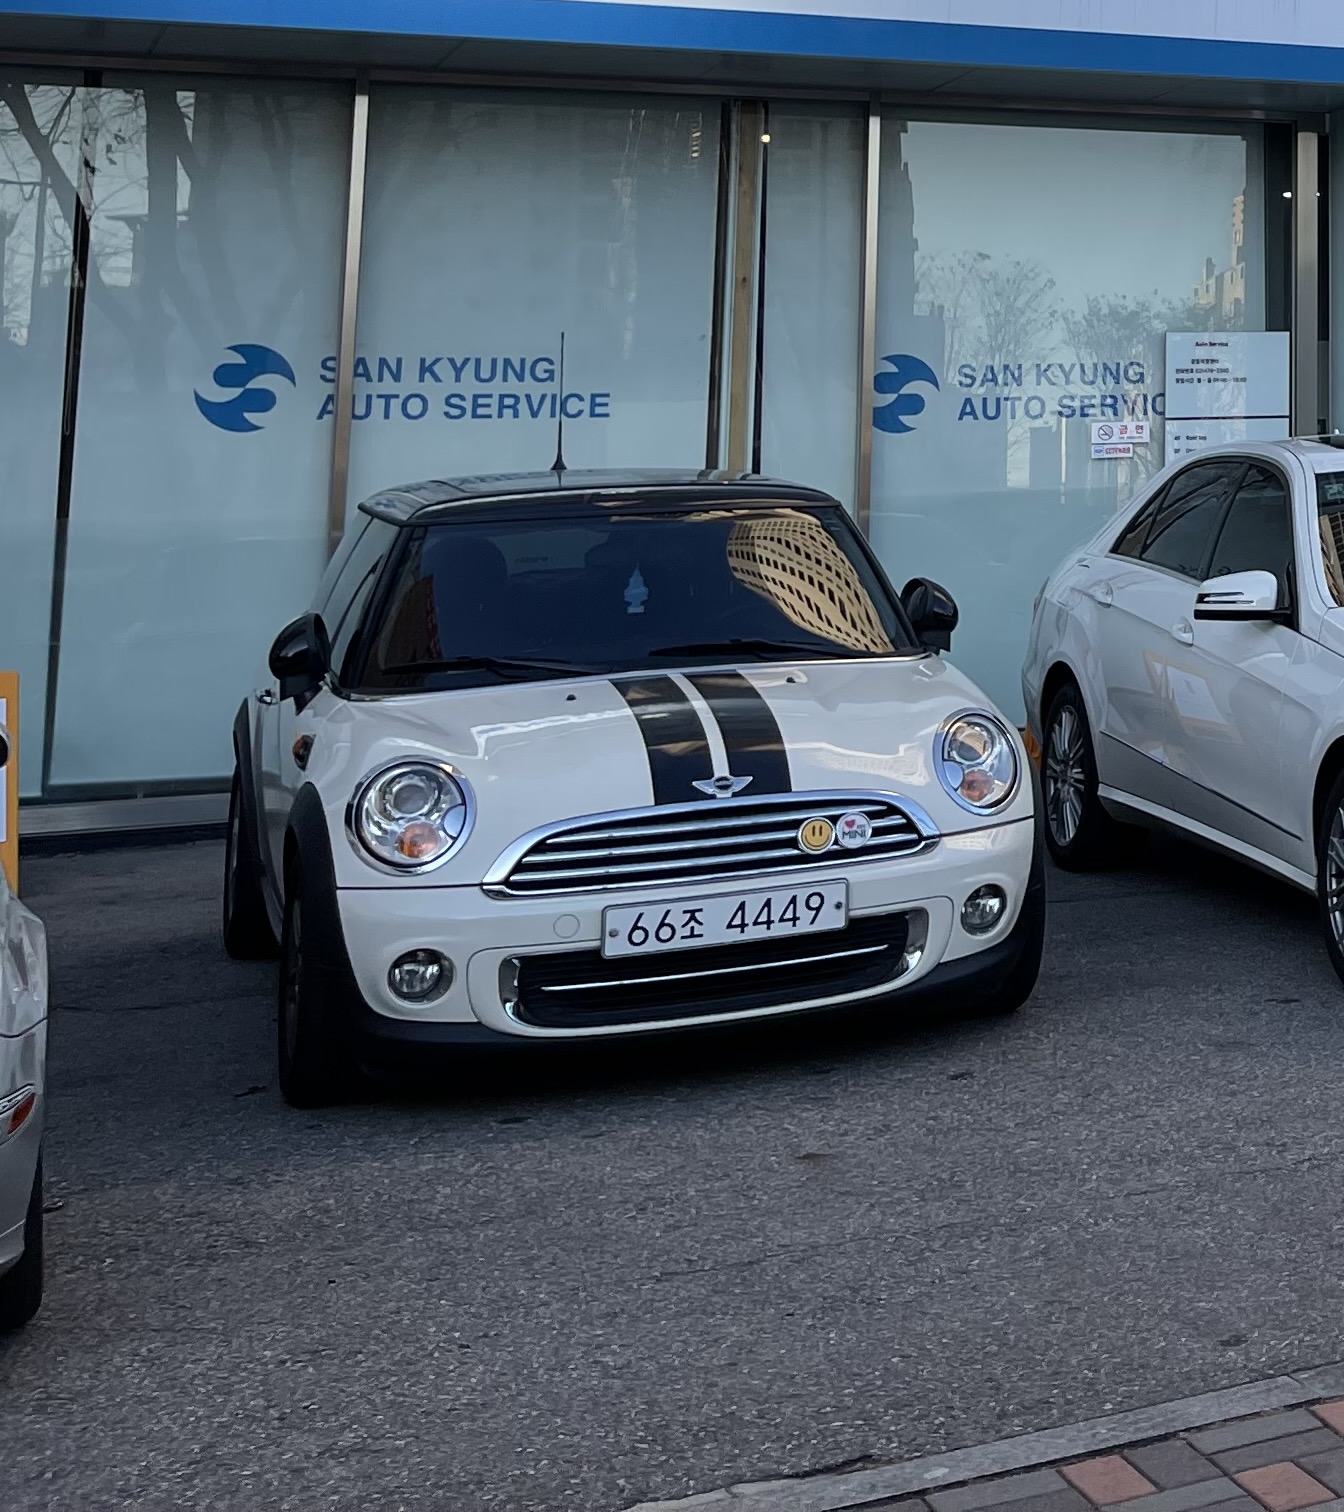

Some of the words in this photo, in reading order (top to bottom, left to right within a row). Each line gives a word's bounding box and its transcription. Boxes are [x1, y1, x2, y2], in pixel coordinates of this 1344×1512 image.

[319, 356, 404, 384] SAN
[418, 356, 556, 384] KYUNG
[957, 363, 1023, 390] SAN
[1034, 360, 1146, 387] KYUNG
[317, 392, 430, 420] AUTO
[443, 392, 611, 420] SERVICE
[957, 395, 1046, 423] AUTO
[1056, 391, 1166, 421] SERVIC
[627, 907, 704, 947] 66조
[725, 891, 825, 934] 4449
